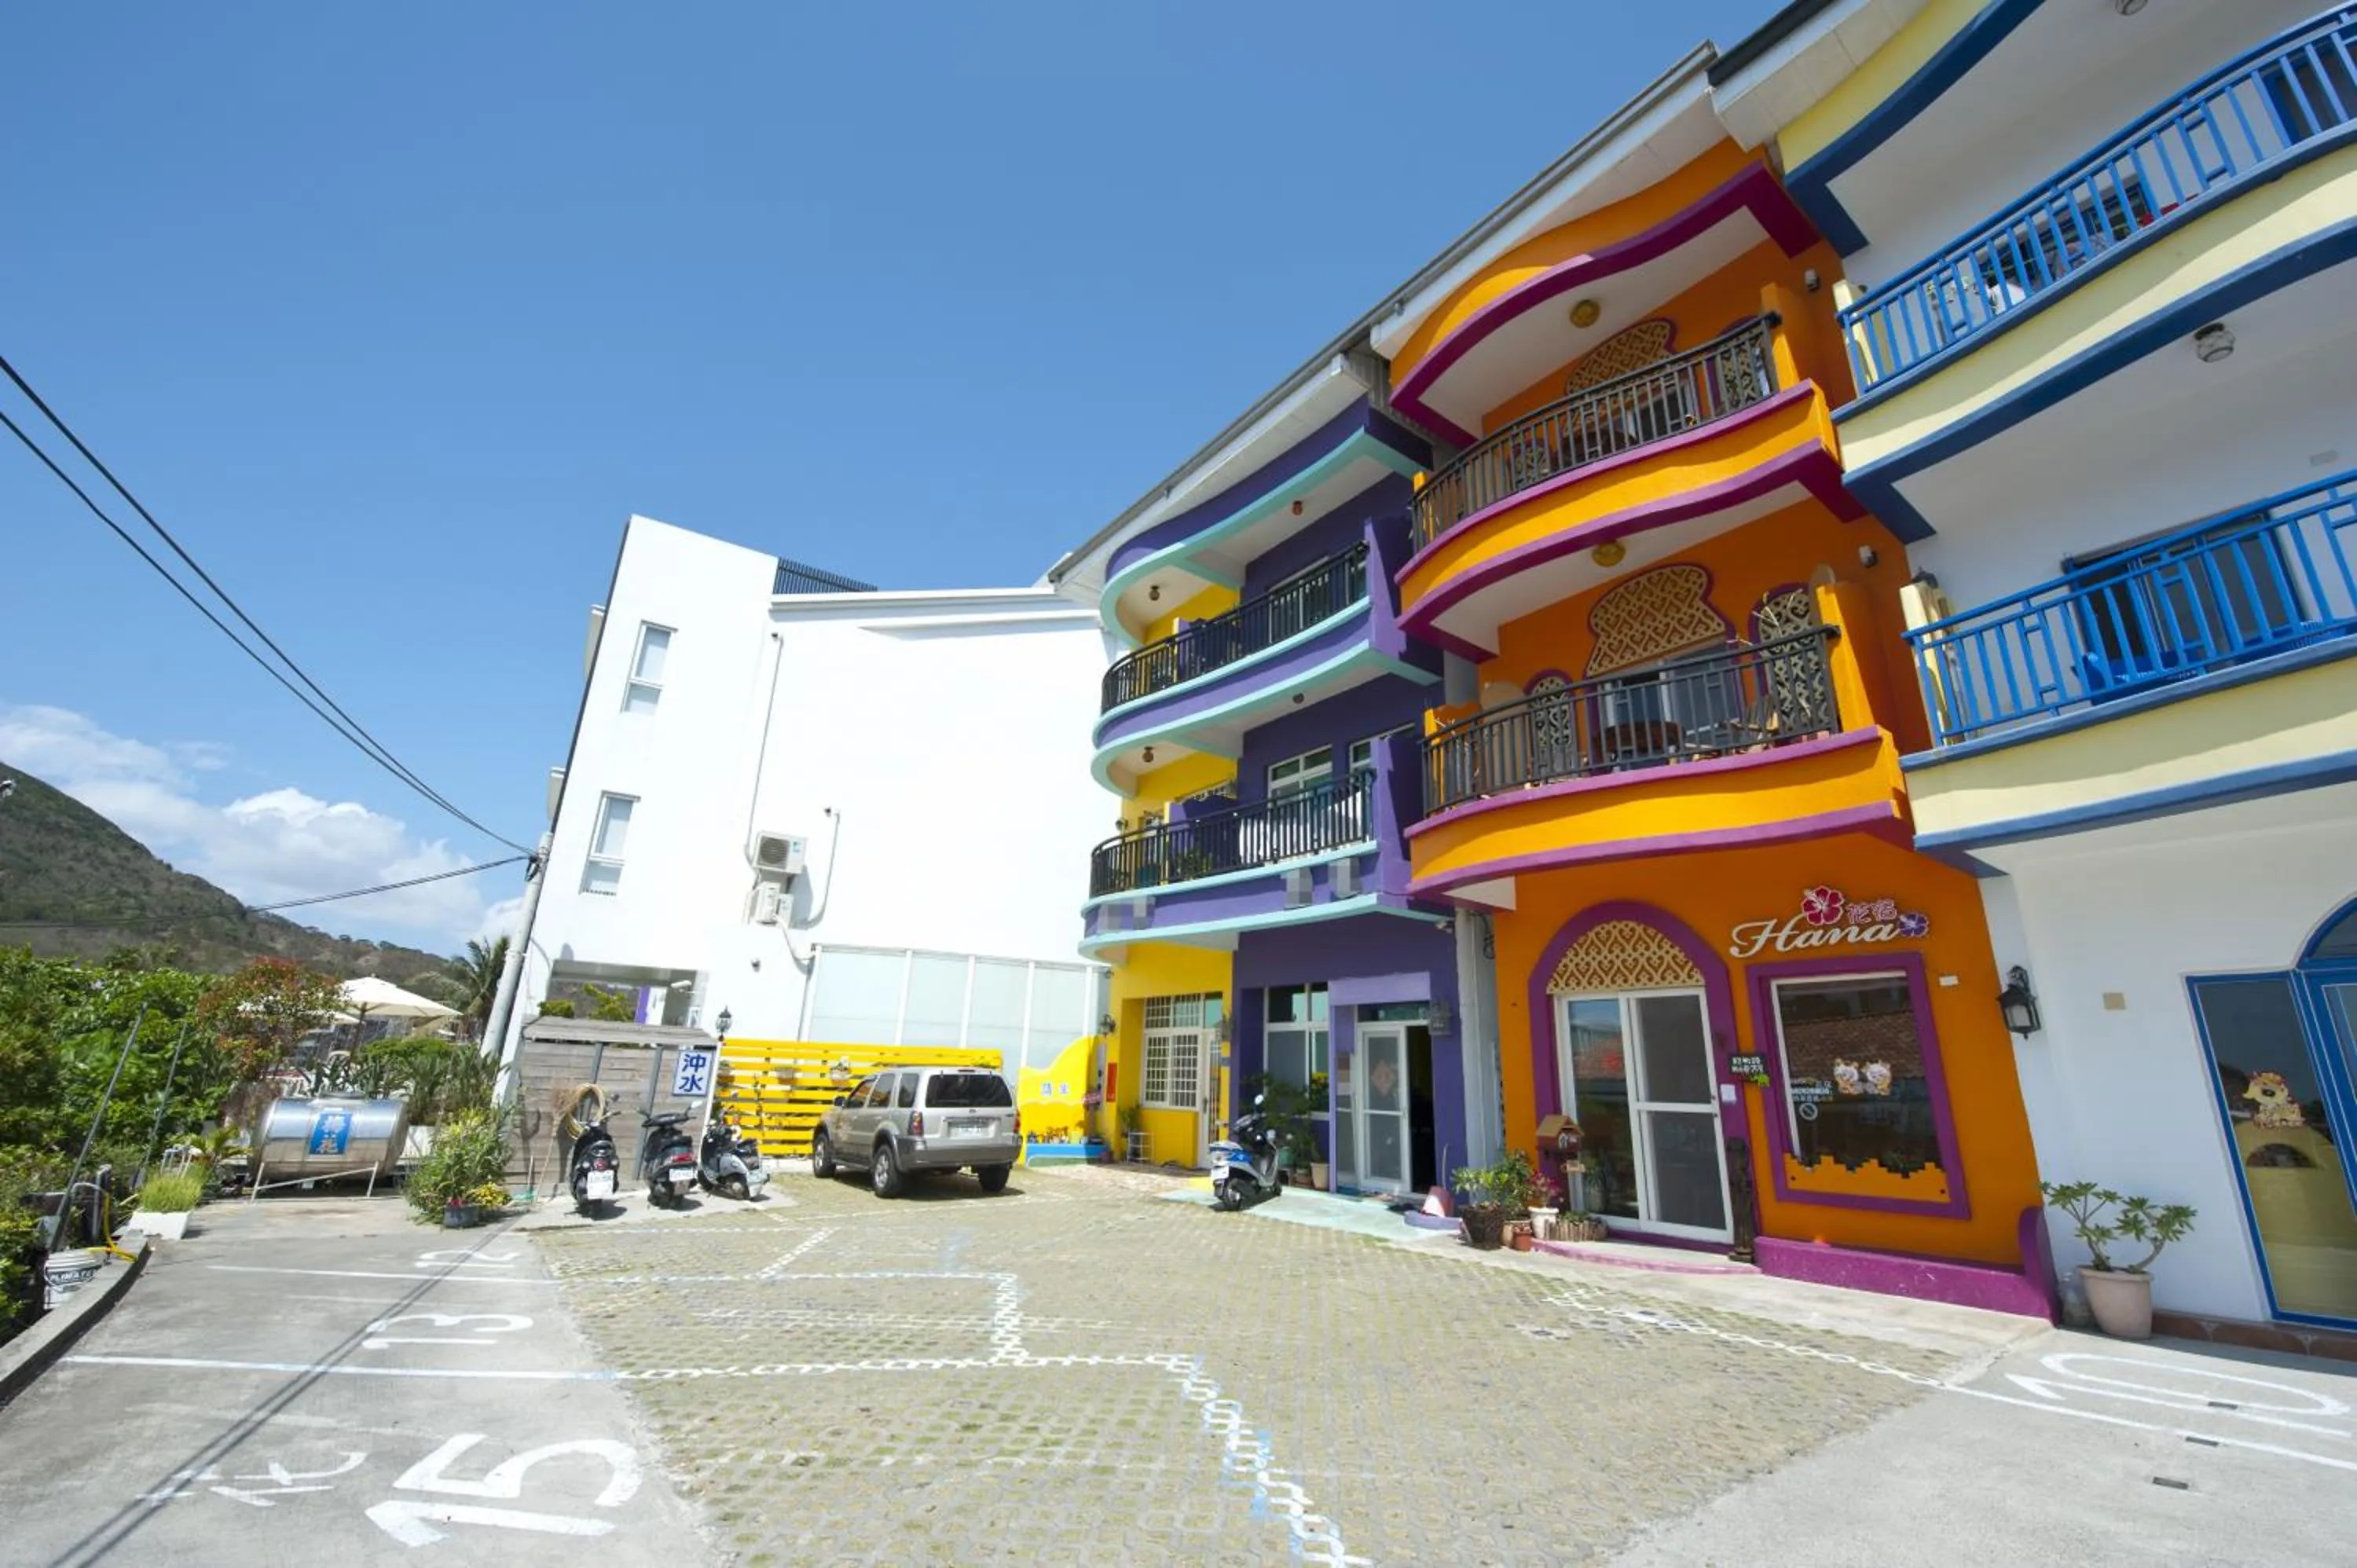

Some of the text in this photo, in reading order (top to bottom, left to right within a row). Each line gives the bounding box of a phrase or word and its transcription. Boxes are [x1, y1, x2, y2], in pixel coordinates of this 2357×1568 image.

[1729, 914, 1900, 958] Hana
[679, 1053, 706, 1092] 沖水
[415, 1249, 519, 1268] 12
[362, 1313, 533, 1349] 13
[2005, 1353, 2351, 1438] 10
[365, 1434, 643, 1546] 15
